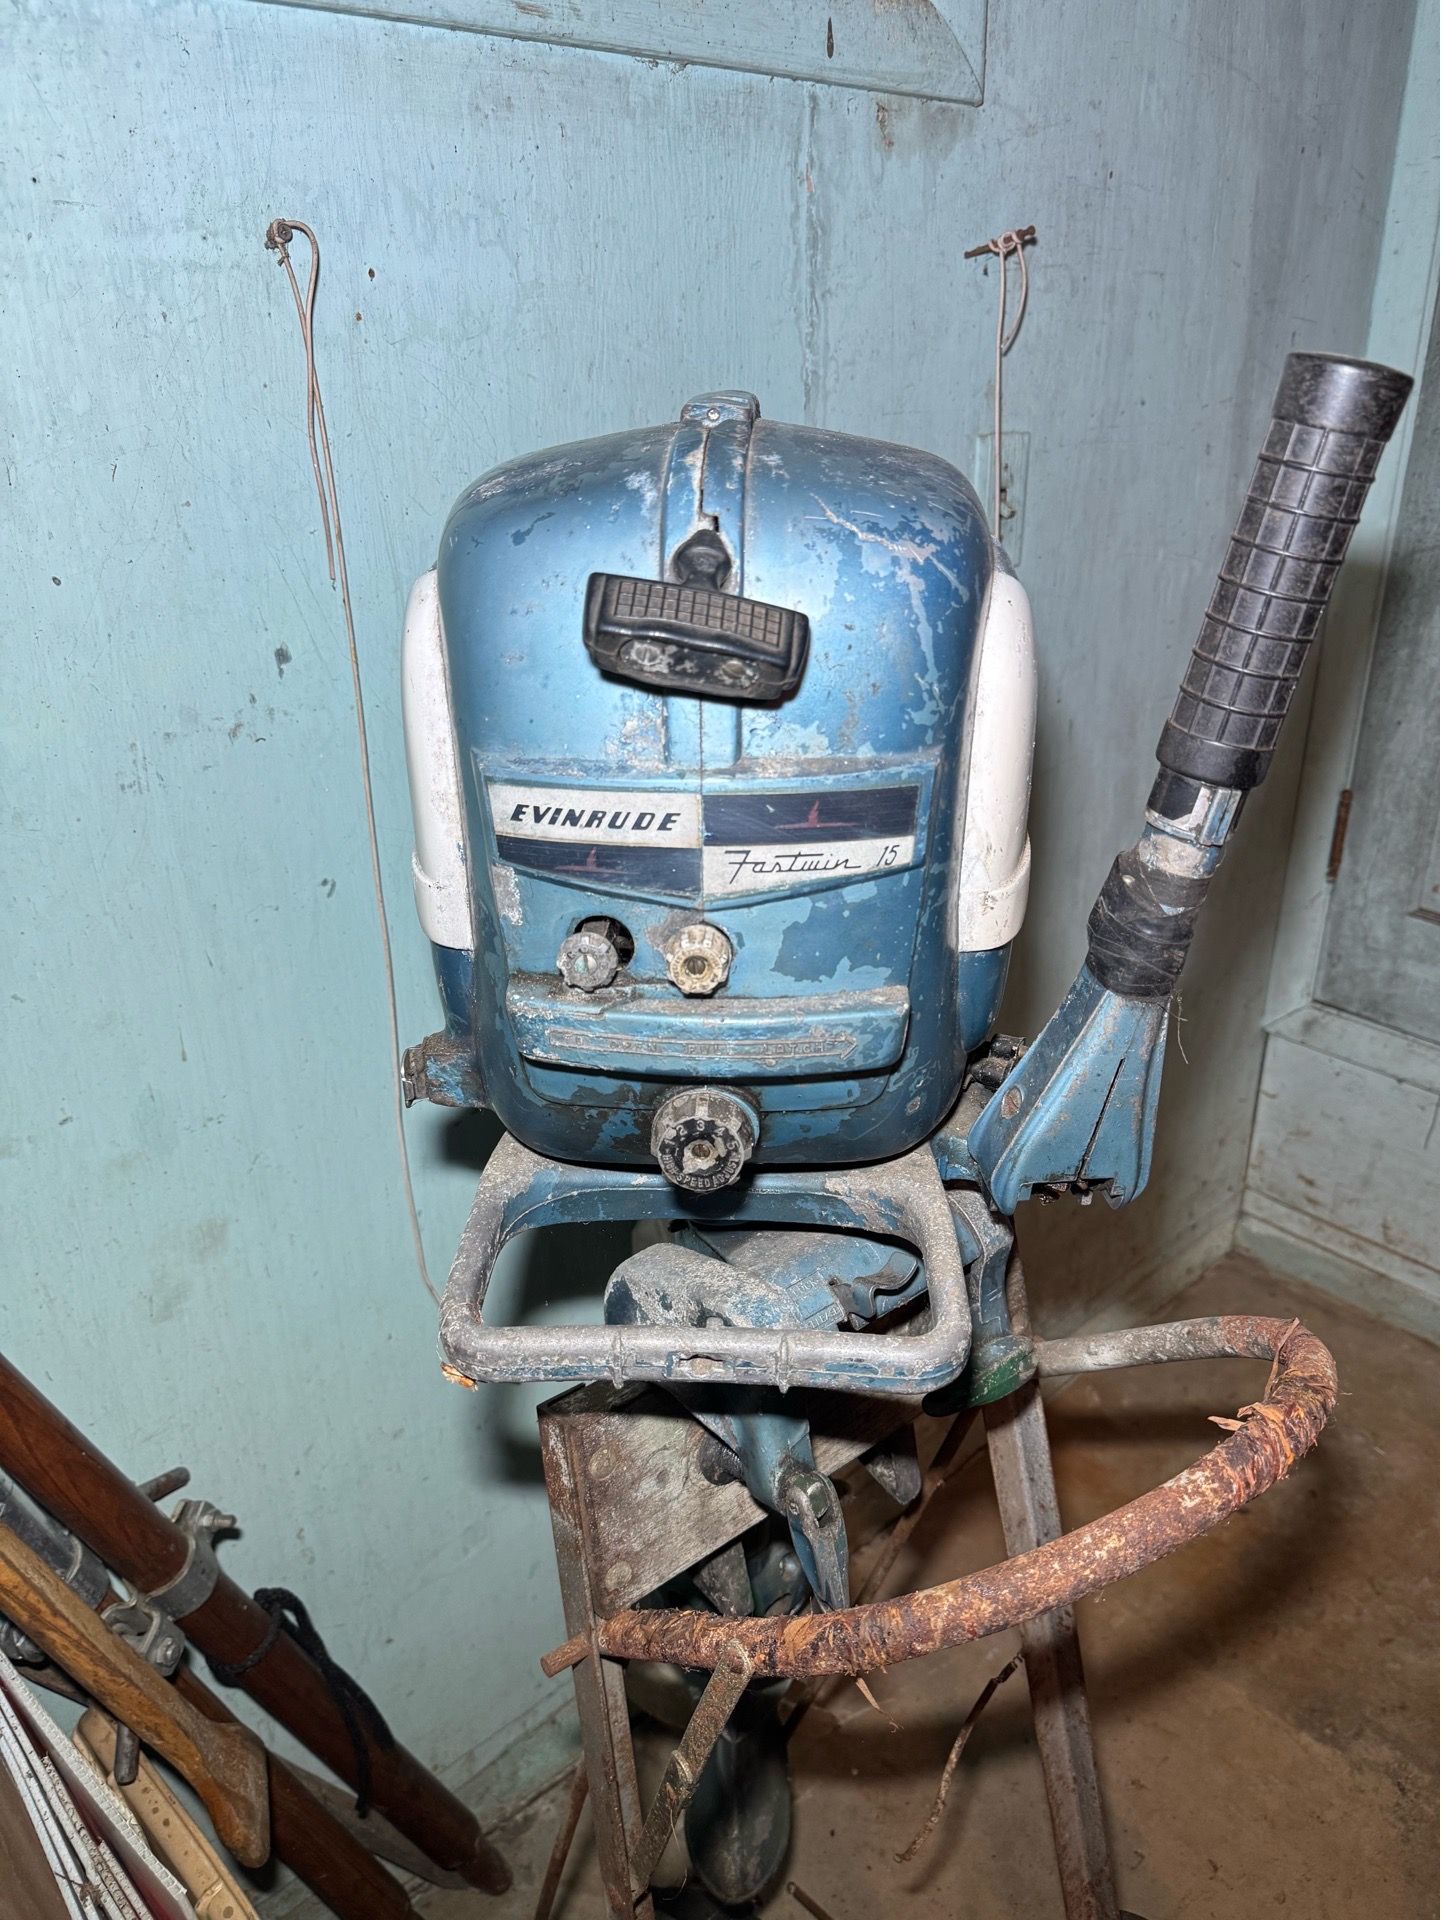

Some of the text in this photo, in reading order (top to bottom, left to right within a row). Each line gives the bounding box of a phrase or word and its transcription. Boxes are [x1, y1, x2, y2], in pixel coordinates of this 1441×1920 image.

[510, 803, 681, 832] EVINRUDE
[723, 844, 900, 885] Fastwin 15
[675, 1124, 688, 1136] 2
[696, 1120, 705, 1131] 3
[714, 1126, 727, 1137] 4
[725, 1140, 738, 1150] 5
[675, 1173, 711, 1188] SPEED
[713, 1157, 740, 1187] ADJUST
